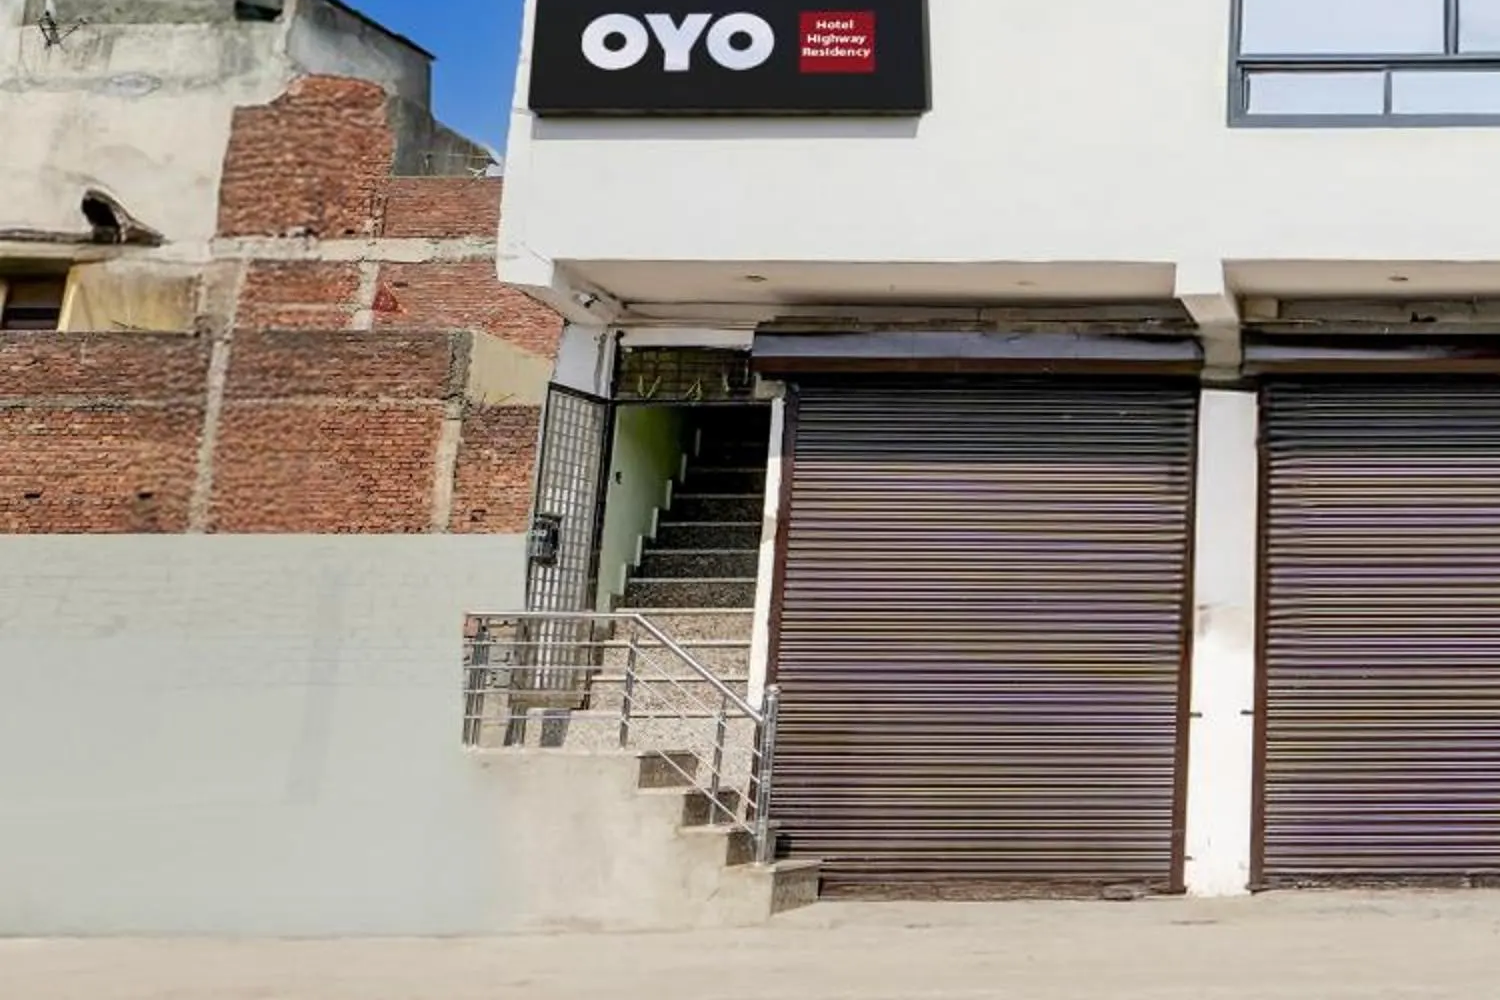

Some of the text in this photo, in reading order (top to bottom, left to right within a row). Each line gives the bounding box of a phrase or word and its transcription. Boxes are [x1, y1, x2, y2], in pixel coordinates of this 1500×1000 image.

[816, 20, 854, 29] Hotel
[581, 12, 775, 72] OYO
[807, 33, 867, 45] Highway
[802, 47, 870, 58] Residency
